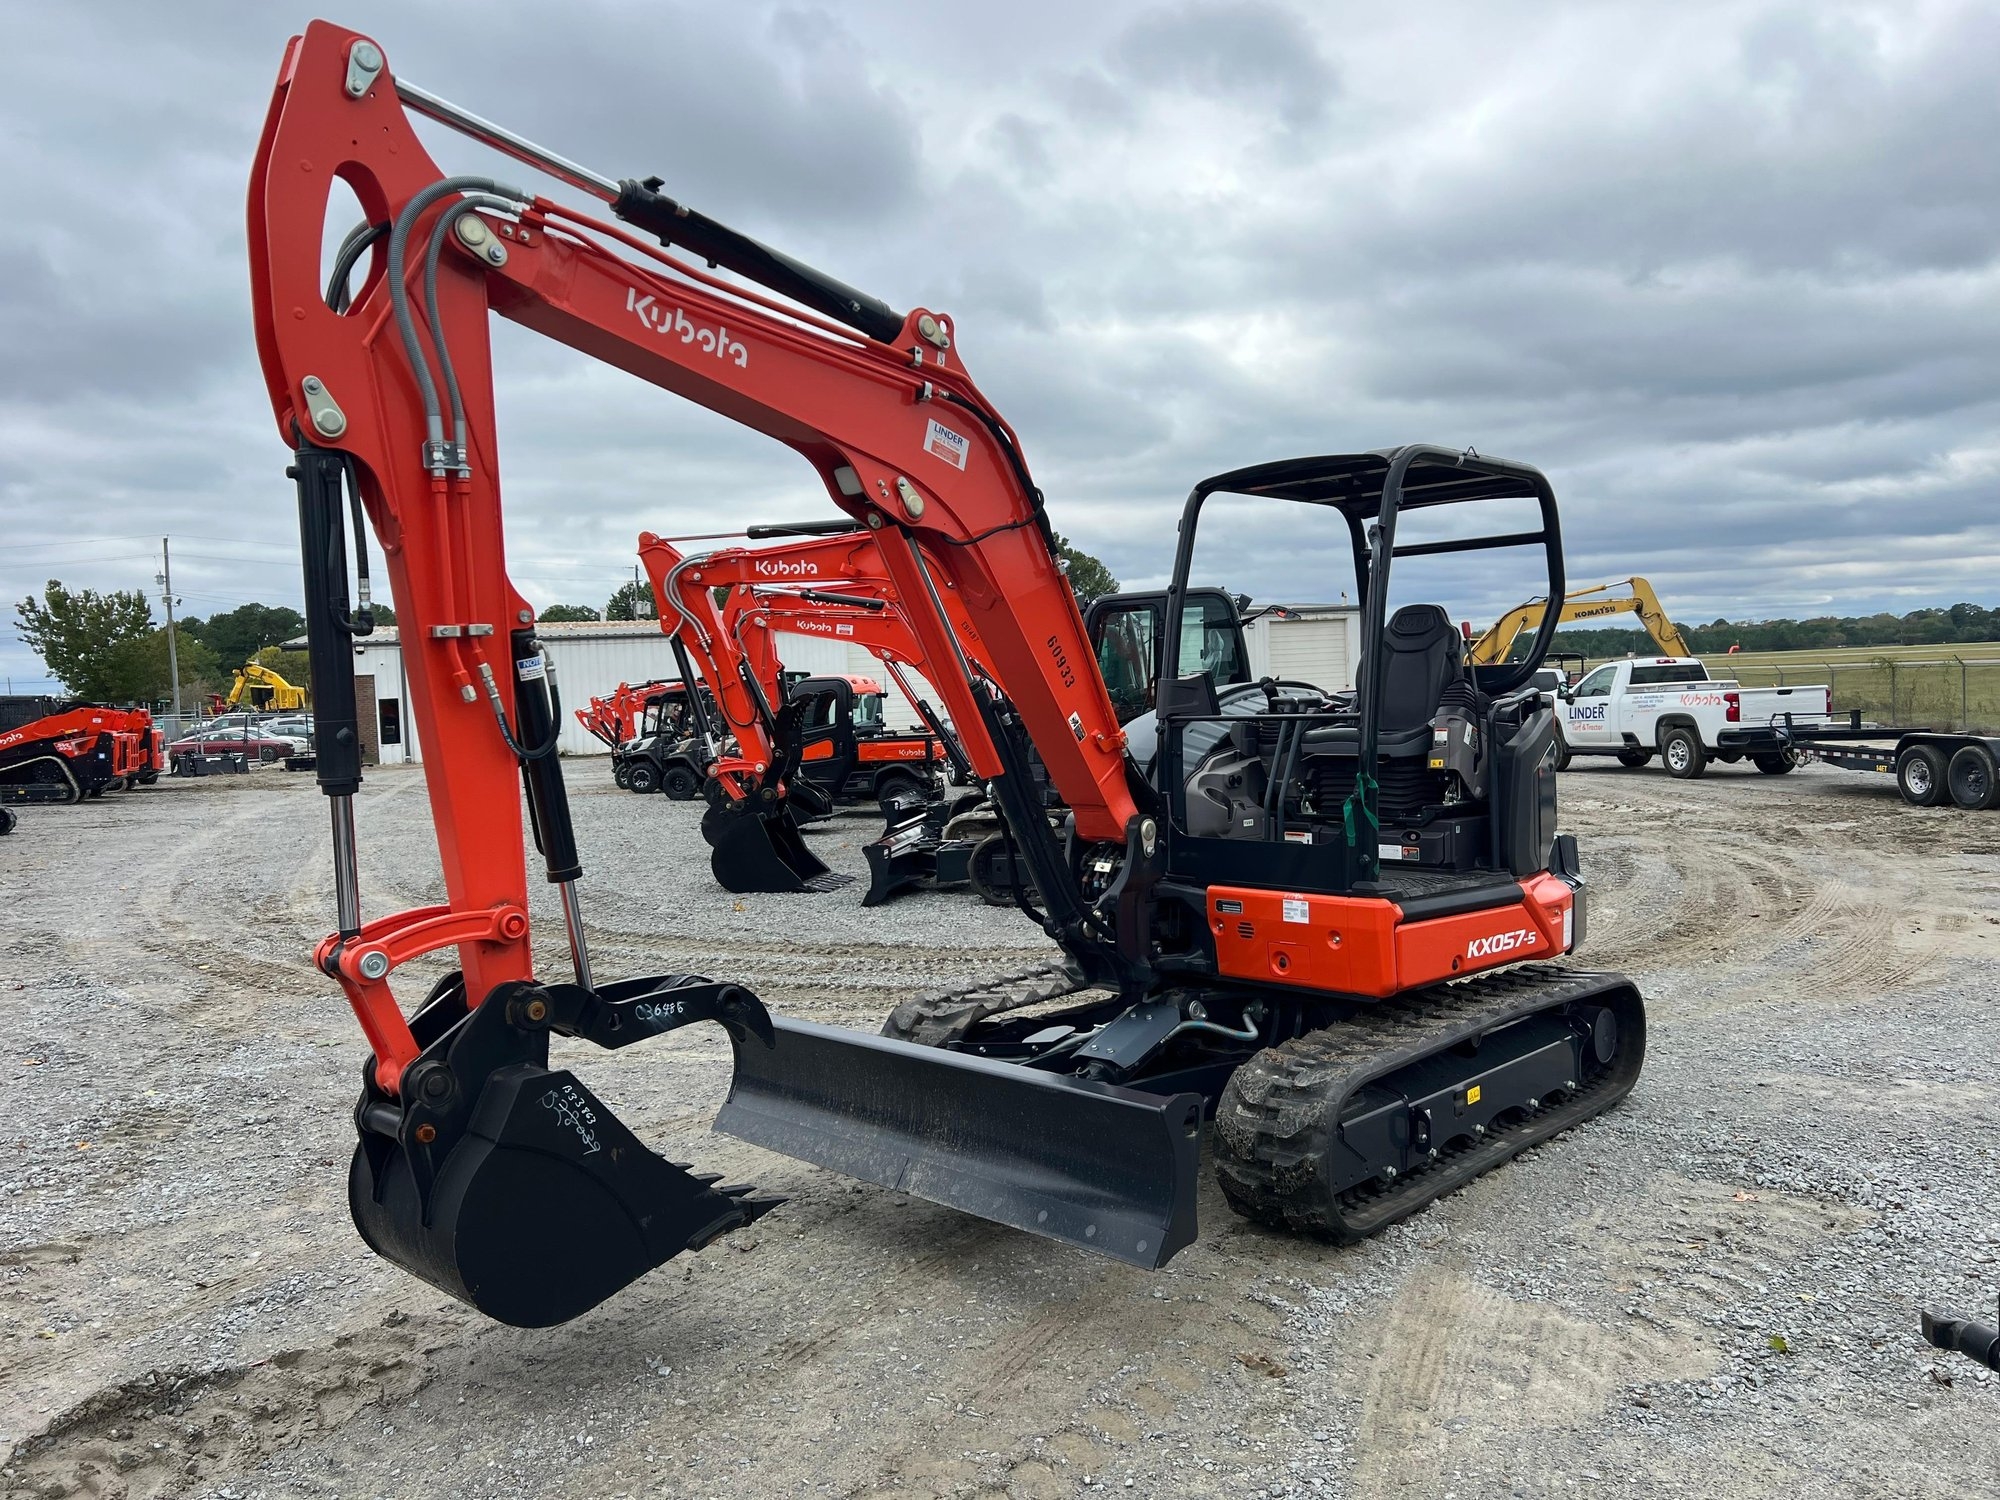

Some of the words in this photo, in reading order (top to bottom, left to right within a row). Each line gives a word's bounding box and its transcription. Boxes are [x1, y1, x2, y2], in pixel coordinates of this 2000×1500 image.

[626, 286, 748, 368] Kubota
[934, 424, 963, 446] LINDER
[755, 560, 818, 575] Kubota
[1574, 606, 1616, 618] KOMATSU
[797, 620, 832, 632] Kubota
[1047, 635, 1075, 688] 60933
[1680, 693, 1722, 706] Kubota
[1569, 706, 1605, 719] LINDER
[1467, 929, 1537, 959] KX057-5
